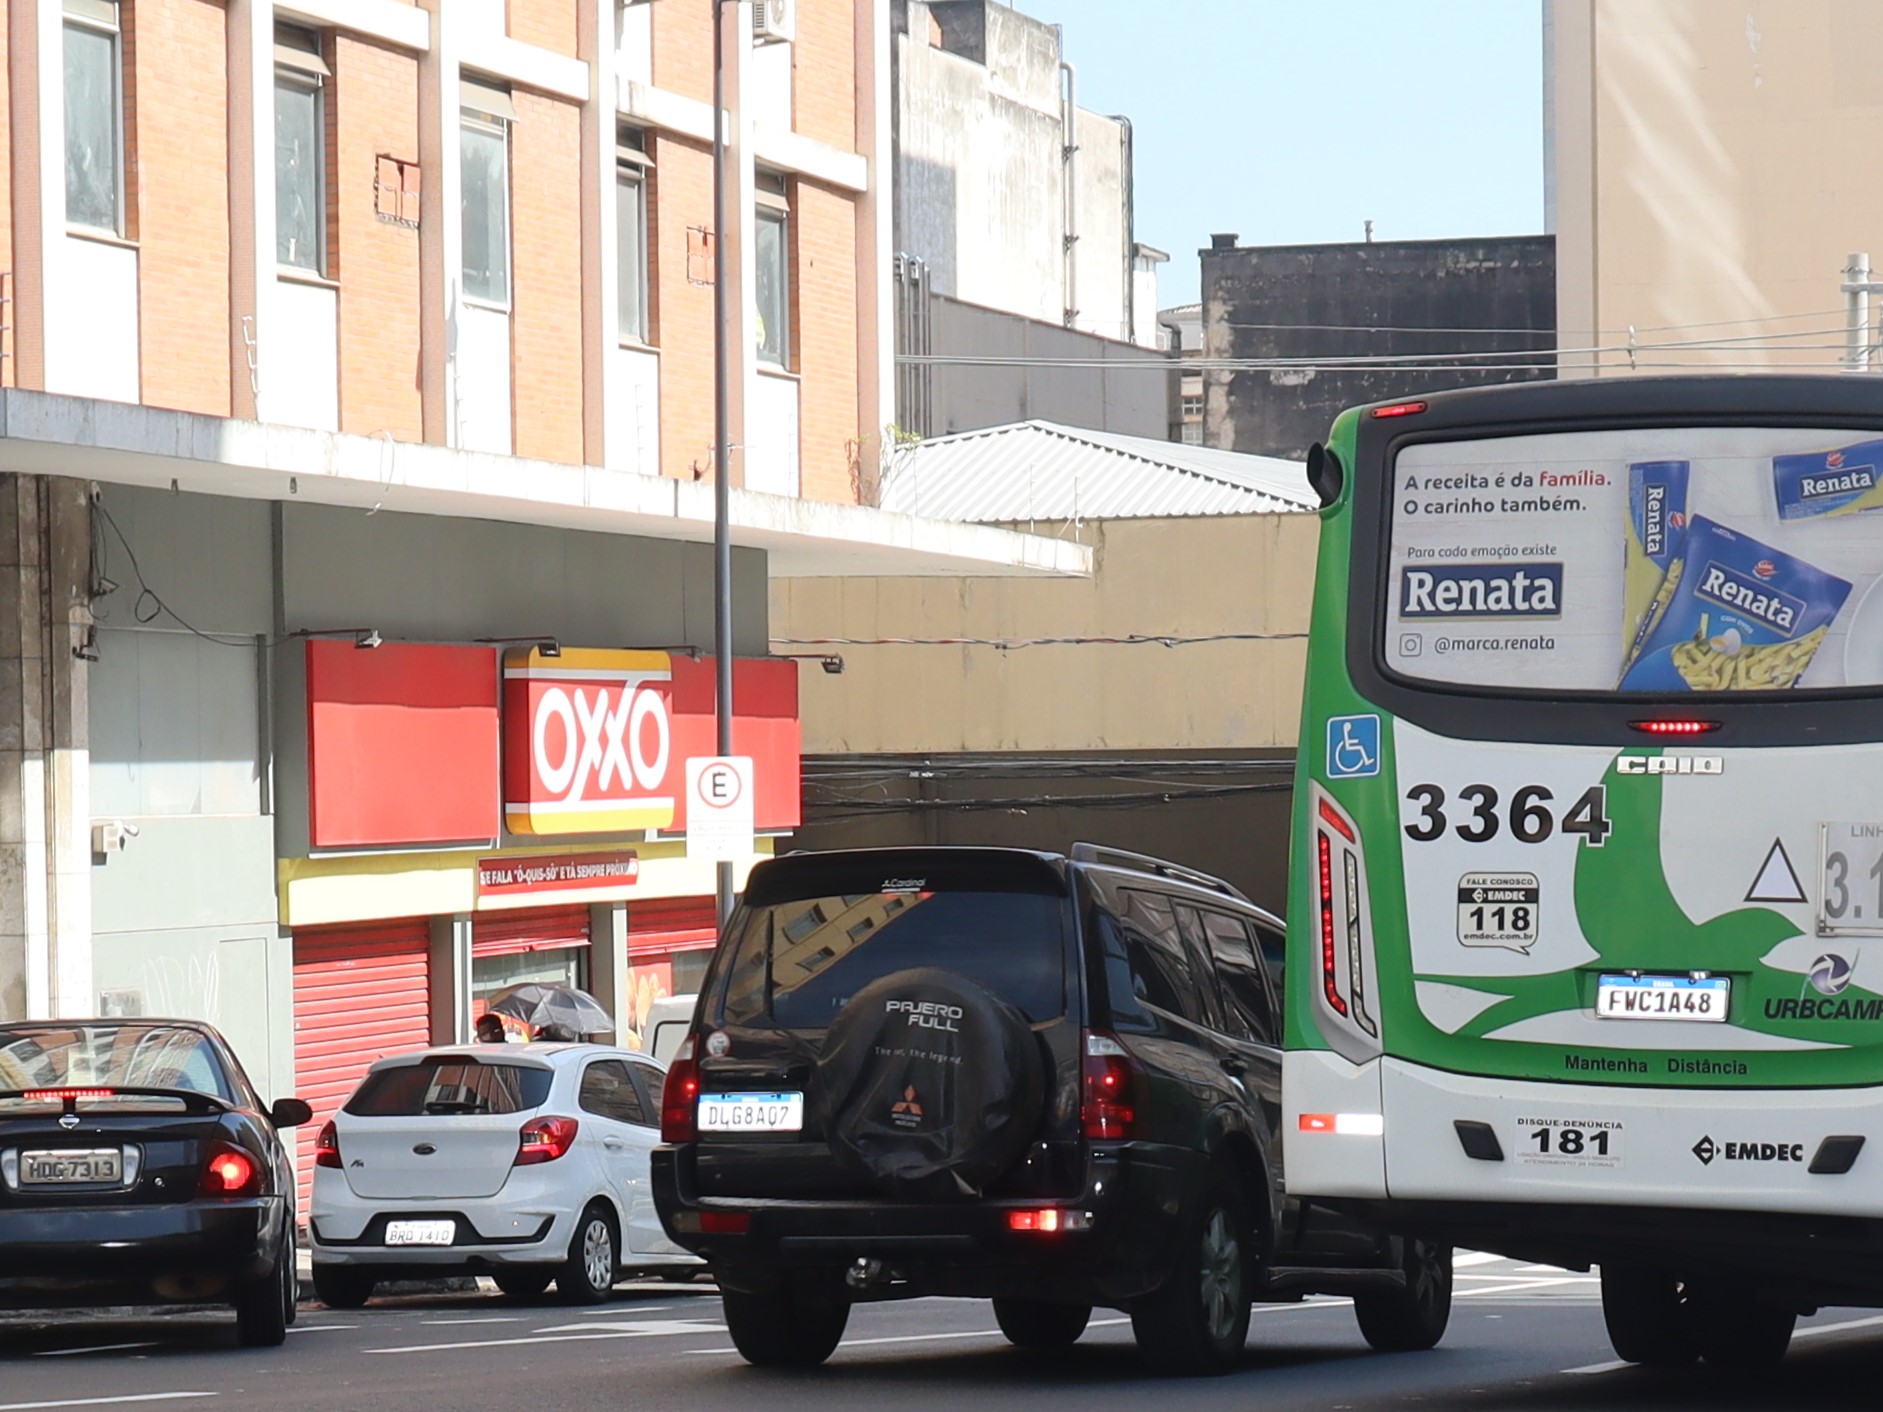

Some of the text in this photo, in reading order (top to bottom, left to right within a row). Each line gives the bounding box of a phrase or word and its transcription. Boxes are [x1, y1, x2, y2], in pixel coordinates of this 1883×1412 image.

[1404, 469, 1612, 490] A receita é da família.
[1801, 470, 1873, 497] Renata
[1404, 495, 1587, 514] O carinho também.
[1646, 486, 1665, 554] Renata
[1407, 544, 1557, 560] Para cada emoção existe
[1404, 569, 1557, 612] Renata
[1702, 567, 1796, 628] Renata
[1434, 635, 1555, 655] @marca.renata
[533, 686, 670, 801] OXXO
[1617, 756, 1723, 773] CAIO
[712, 772, 727, 798] E
[1404, 783, 1611, 845] 3364
[480, 870, 491, 885] SE
[492, 869, 513, 885] FALA
[566, 861, 577, 879] TÁ
[577, 862, 605, 878] SEMPRE
[1466, 878, 1533, 886] FALE CONOSCO
[1487, 890, 1526, 901] EMDEC
[1469, 906, 1531, 932] 118
[1463, 932, 1534, 941] emdec.com.br
[885, 1000, 964, 1019] PAJERO
[1608, 990, 1712, 1014] FWC1A48
[908, 1014, 959, 1033] FULL
[1565, 1055, 1748, 1075] Mantenha Distância
[1517, 1118, 1623, 1129] DISQUE-DENÚNCIA
[1531, 1127, 1609, 1155] 181
[1725, 1142, 1804, 1162] EMDEC
